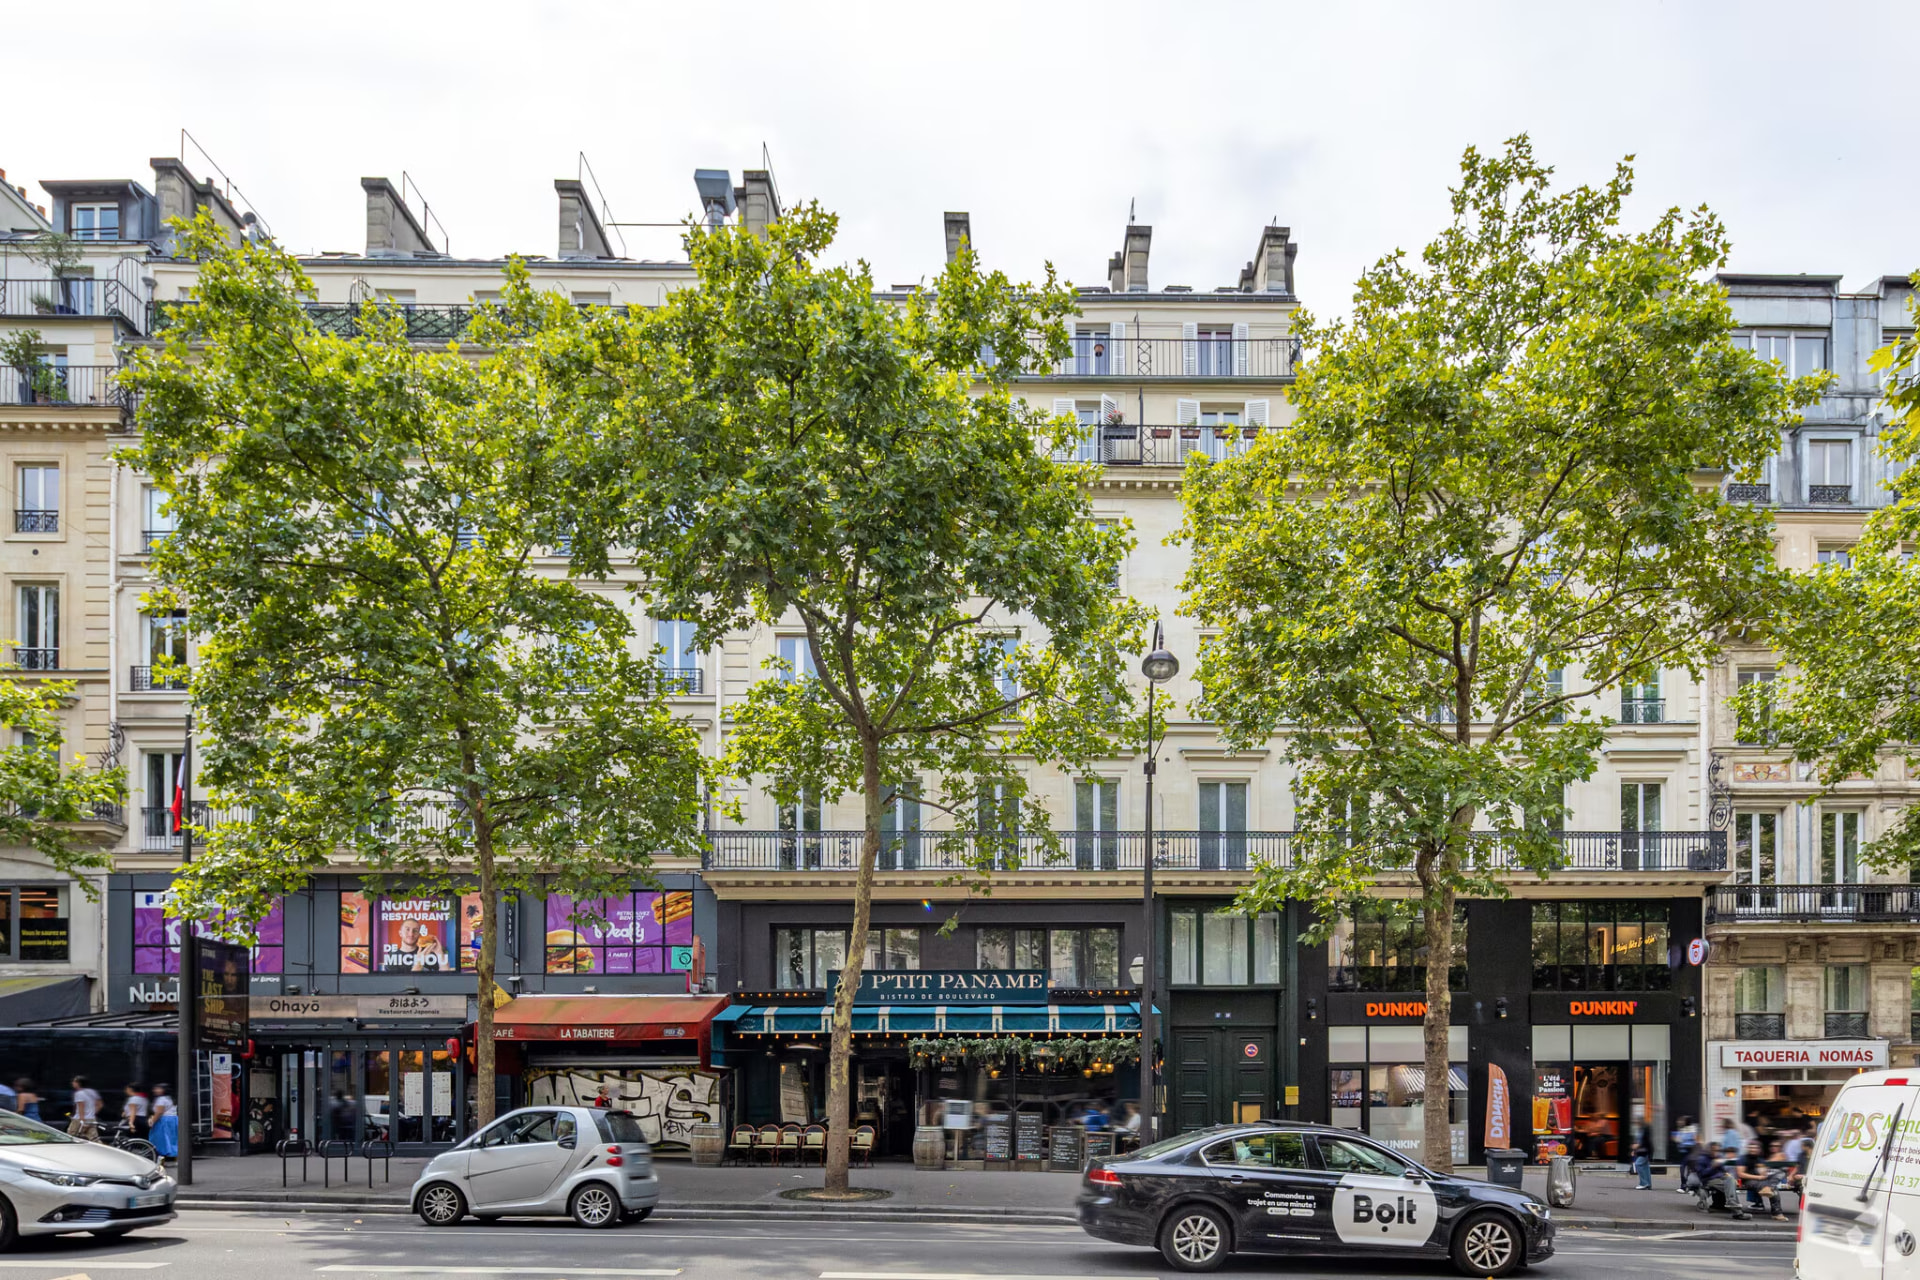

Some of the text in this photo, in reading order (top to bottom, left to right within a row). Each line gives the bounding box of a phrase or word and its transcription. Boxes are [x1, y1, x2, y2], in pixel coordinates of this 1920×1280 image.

[381, 912, 451, 921] RESTAURANT
[383, 944, 398, 953] DE
[383, 954, 449, 966] MICHOU
[202, 968, 215, 982] THE
[938, 974, 1043, 989] PANAME
[202, 981, 223, 999] LAST
[204, 998, 225, 1015] SHIP
[389, 998, 430, 1008] おはよう
[1570, 1001, 1638, 1016] DUNKIN'
[560, 1028, 615, 1038] LA TABATIERE
[1735, 1048, 1874, 1062] TAQUERIA NOMÁS
[1829, 1112, 1884, 1152] JBS
[1894, 1176, 1920, 1189] 02 37
[1264, 1191, 1305, 1200] Commandez
[1247, 1198, 1267, 1207] trajet
[1353, 1194, 1417, 1232] Bolt
